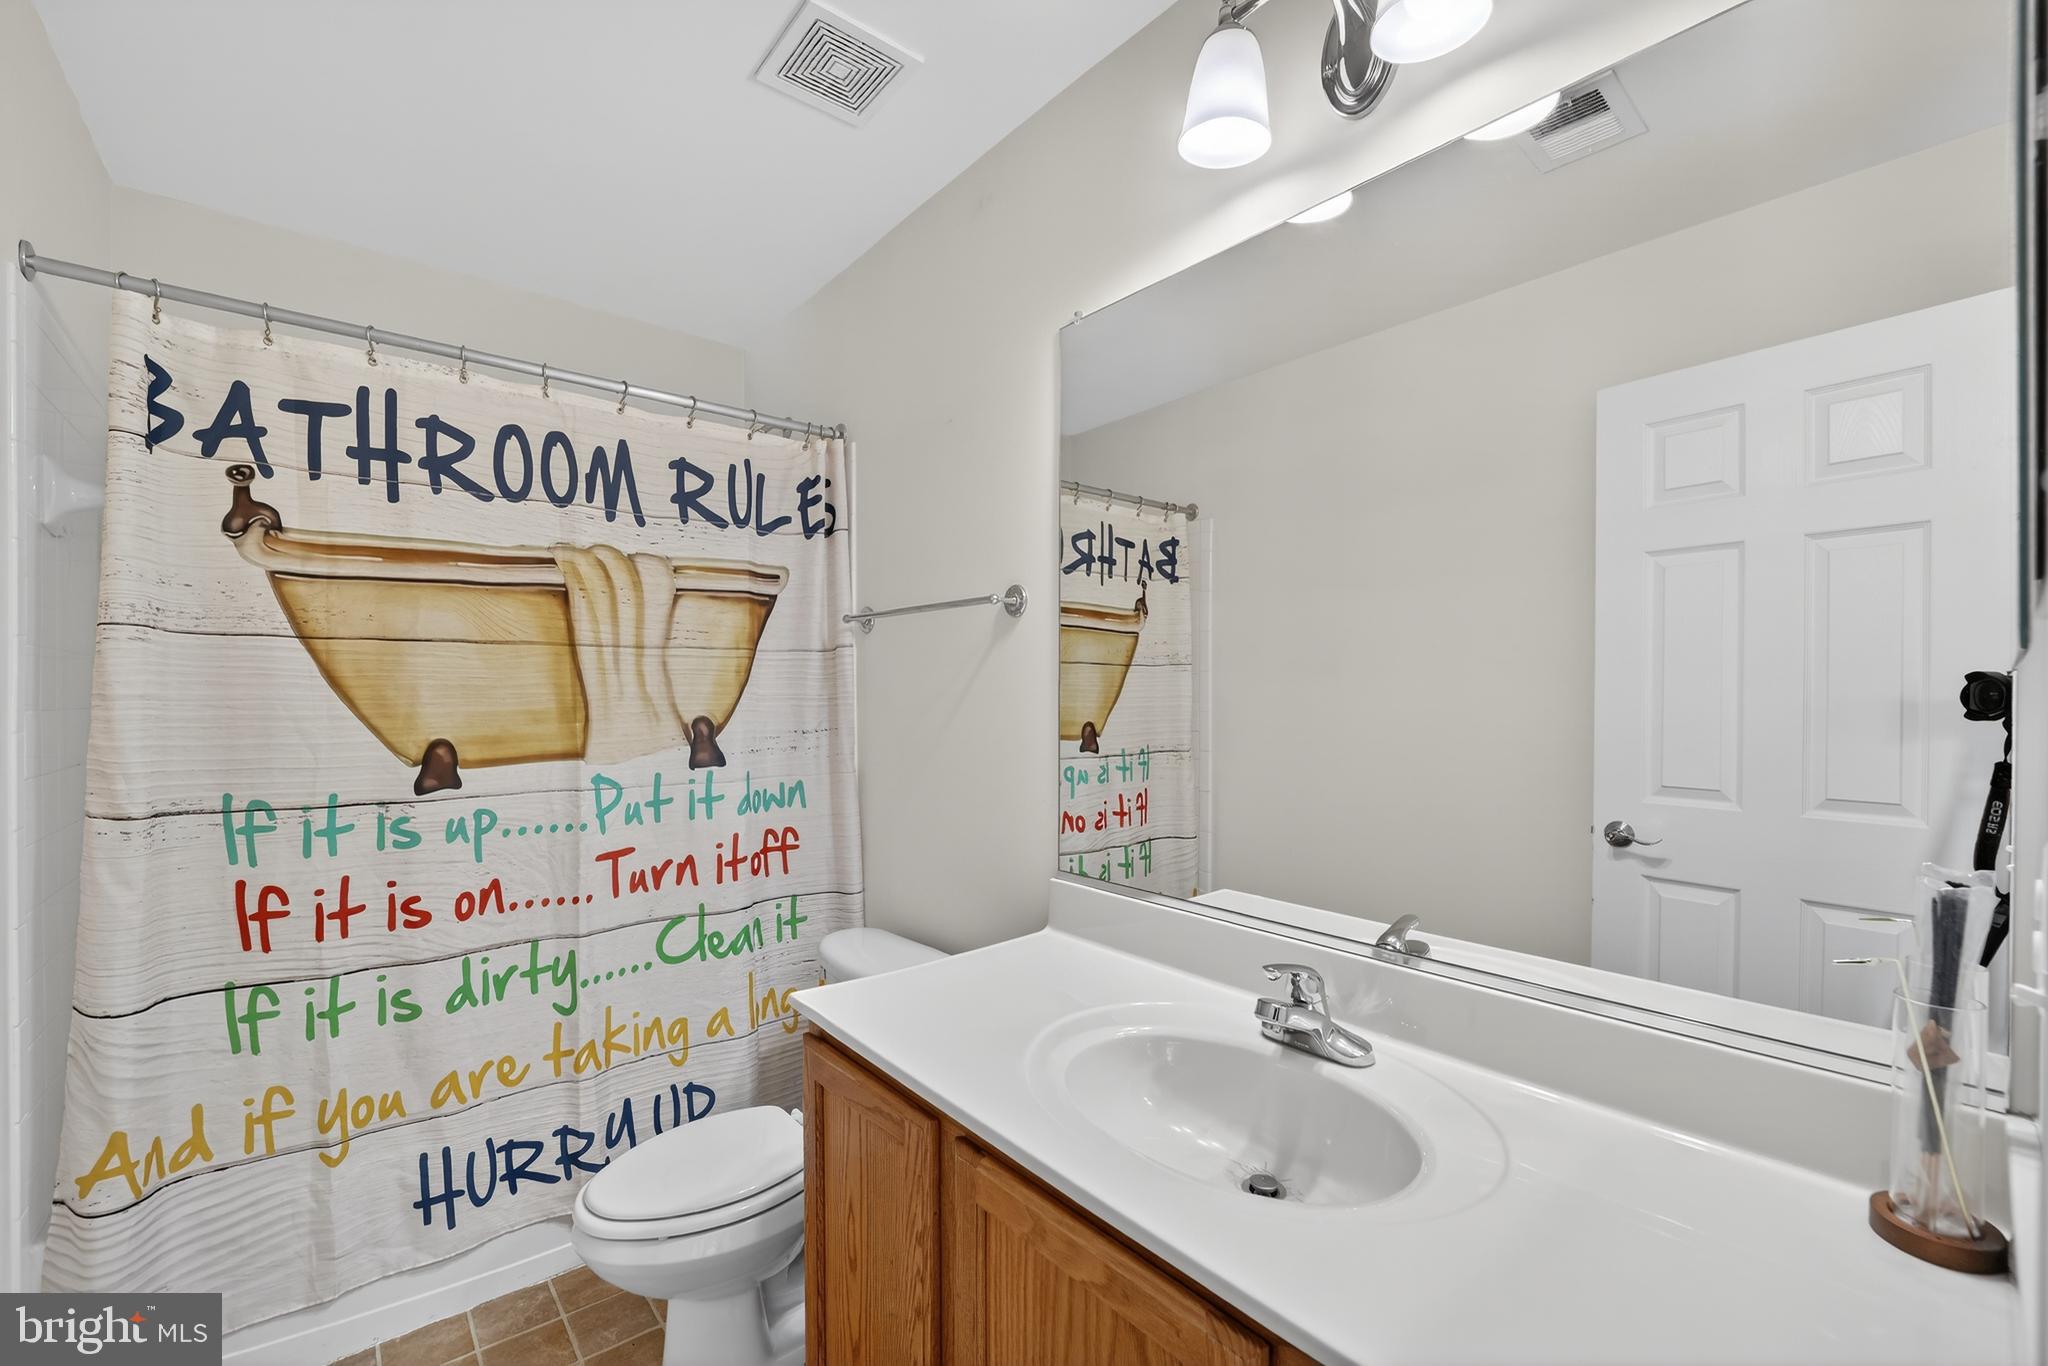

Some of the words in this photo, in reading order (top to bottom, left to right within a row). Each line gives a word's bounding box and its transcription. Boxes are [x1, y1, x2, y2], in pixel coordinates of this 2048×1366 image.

[144, 353, 647, 529] BATHROOM
[222, 792, 277, 869] If
[302, 792, 355, 860] it
[376, 808, 422, 851] is
[688, 769, 725, 820] it
[737, 770, 807, 816] down
[223, 980, 281, 1056] If
[304, 973, 356, 1042] it
[377, 974, 422, 1027] is
[775, 894, 808, 943] it
[234, 878, 290, 954] If
[314, 875, 367, 944] it
[386, 880, 433, 932] is
[75, 1104, 214, 1201] And
[242, 1085, 296, 1156] if
[316, 1087, 408, 1169] you
[429, 1055, 530, 1110] are
[542, 1006, 690, 1069] taking
[706, 1006, 735, 1038] a
[747, 972, 801, 1035] lng
[413, 1097, 637, 1231] HURRY
